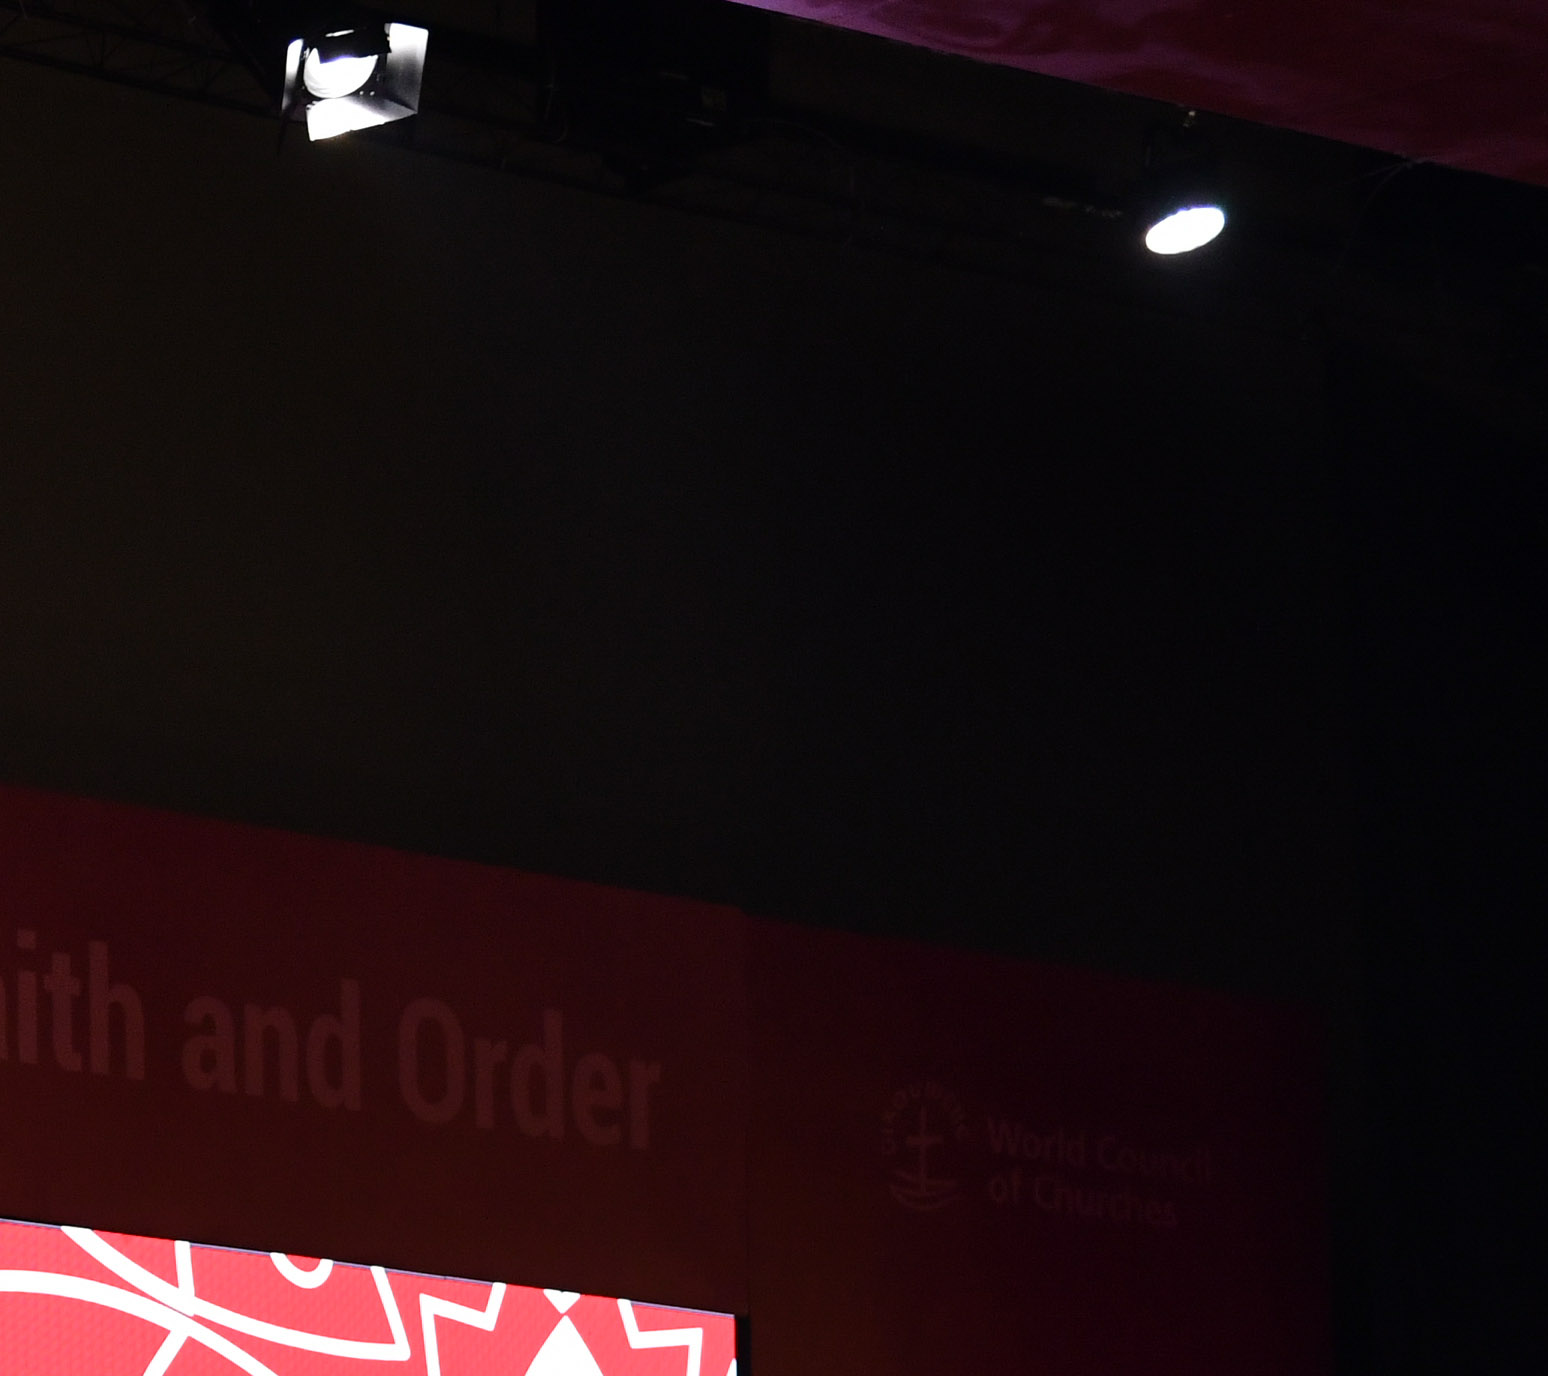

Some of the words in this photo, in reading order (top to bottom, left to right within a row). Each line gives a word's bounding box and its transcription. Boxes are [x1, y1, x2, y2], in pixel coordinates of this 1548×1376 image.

[181, 979, 362, 1111] and
[398, 999, 662, 1151] Order
[987, 1117, 1086, 1168] World
[989, 1166, 1022, 1205] of
